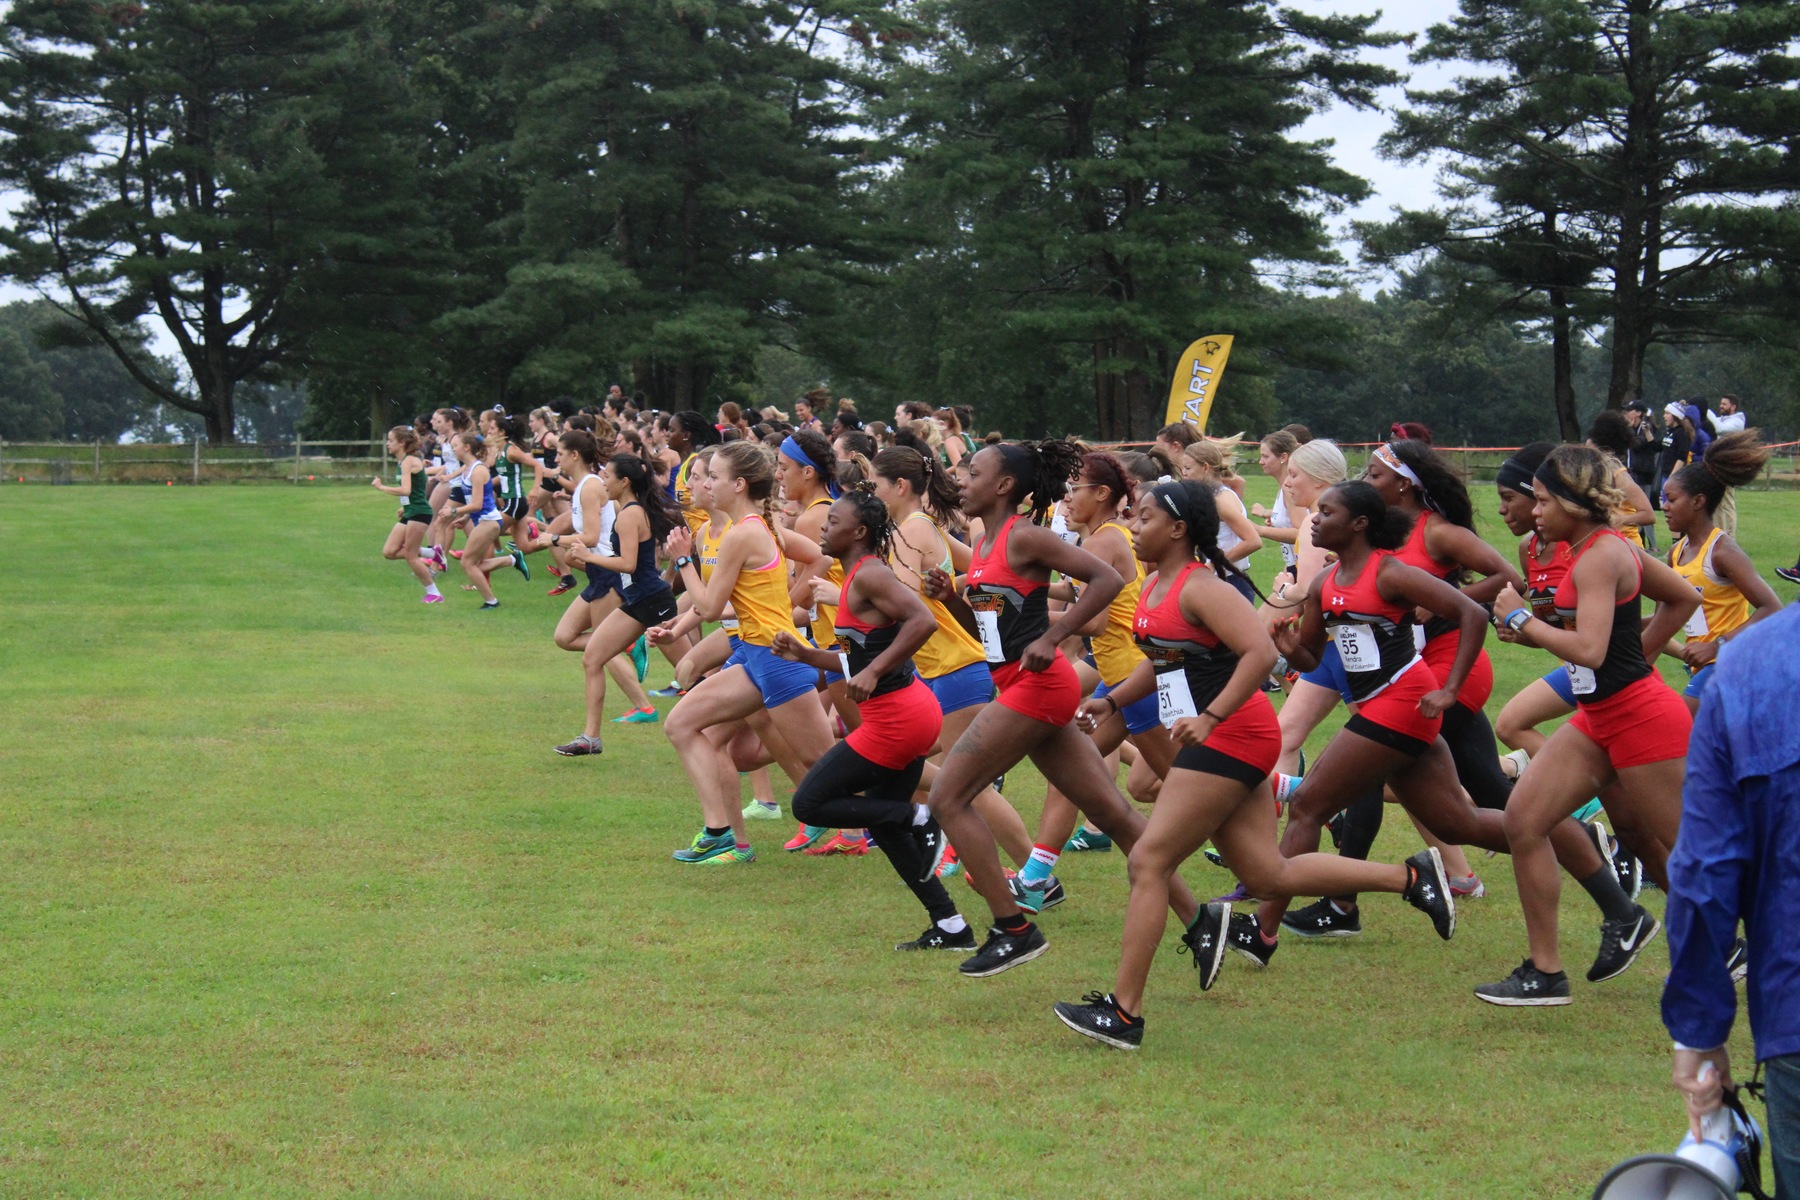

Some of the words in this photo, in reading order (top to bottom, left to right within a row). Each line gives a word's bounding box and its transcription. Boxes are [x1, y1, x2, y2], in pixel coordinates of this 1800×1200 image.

[1181, 358, 1213, 426] TART
[1342, 639, 1359, 655] 55
[1160, 691, 1172, 709] 51
